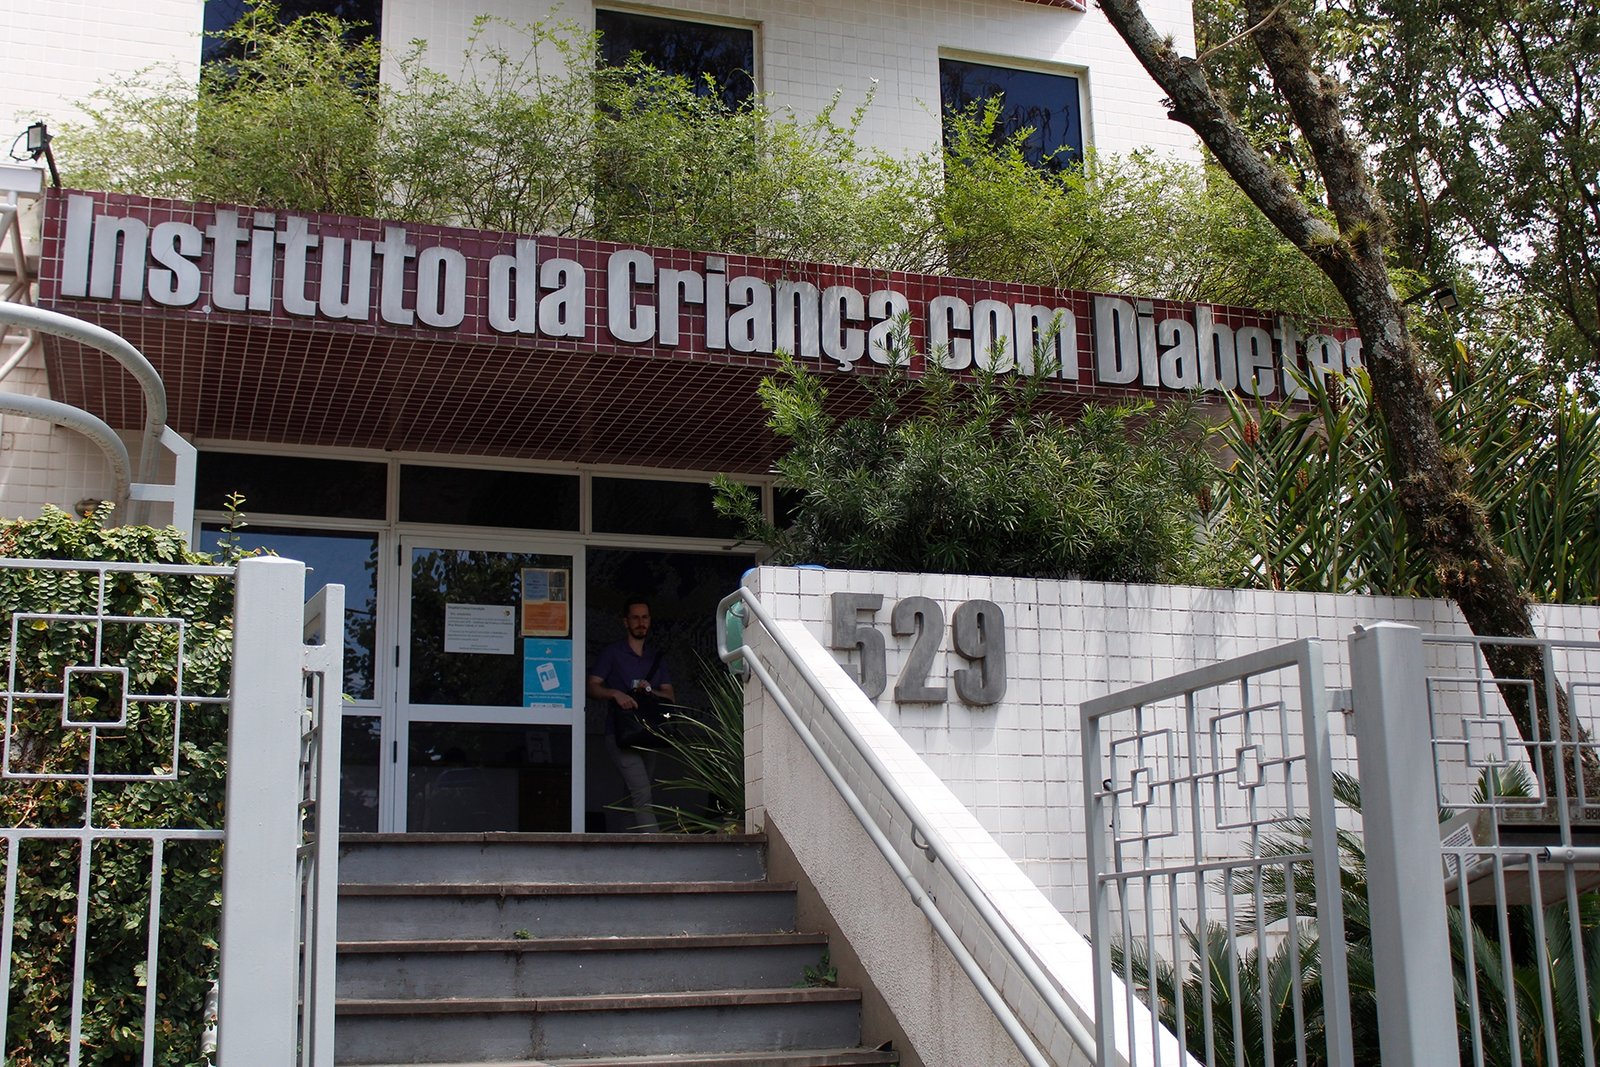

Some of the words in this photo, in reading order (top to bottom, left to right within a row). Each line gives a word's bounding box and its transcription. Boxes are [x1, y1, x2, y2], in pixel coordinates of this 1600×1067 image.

[61, 195, 467, 328] Instituto
[488, 240, 586, 338] da
[608, 250, 909, 371] Criança
[929, 296, 1079, 380] com
[831, 592, 1007, 706] 529
